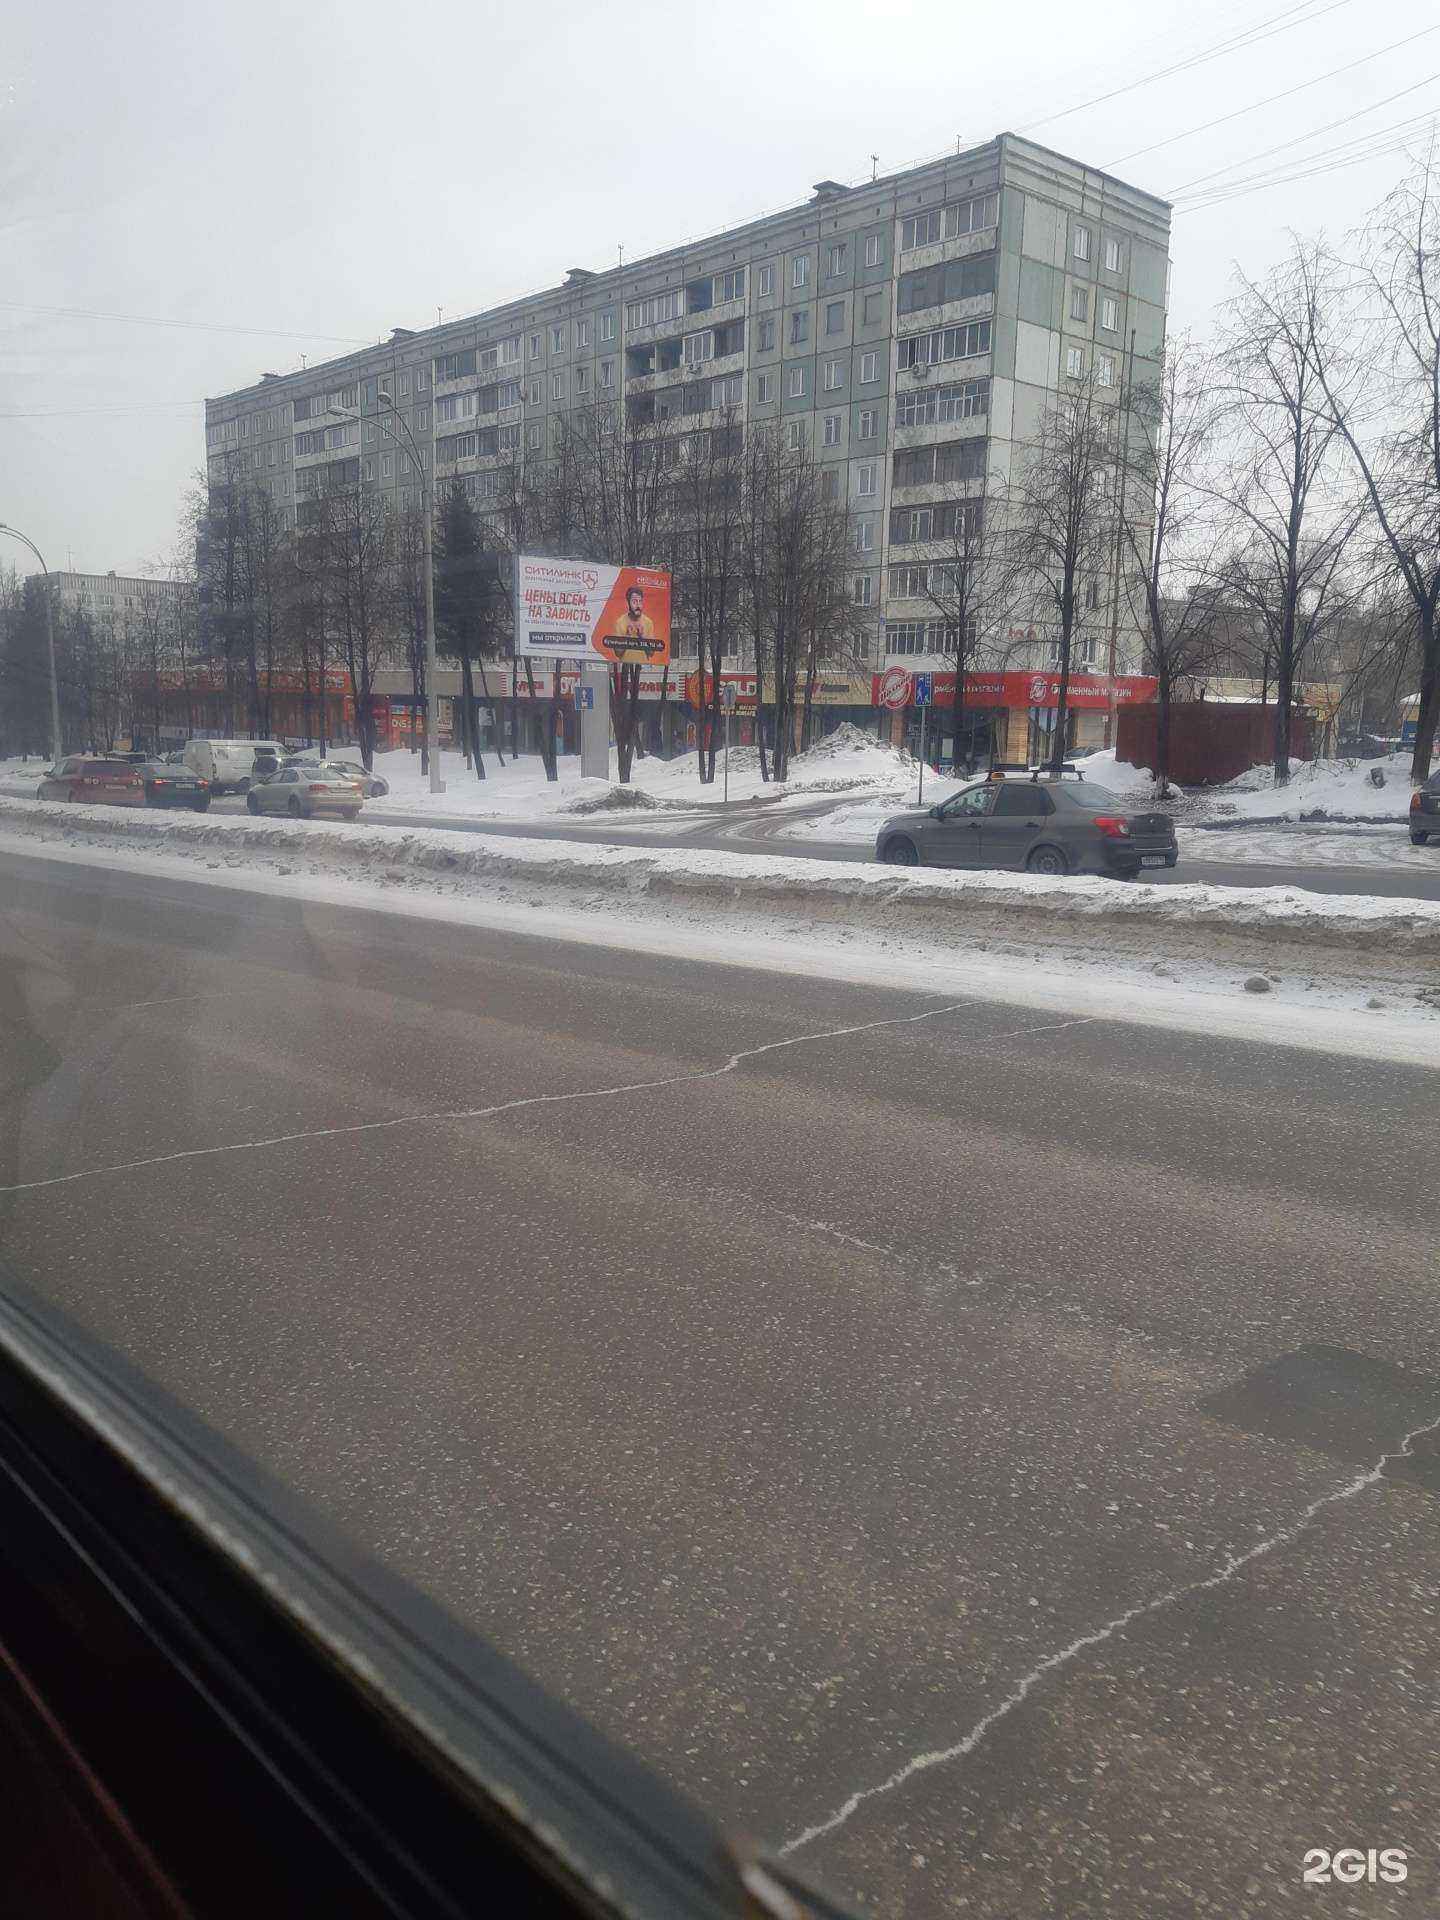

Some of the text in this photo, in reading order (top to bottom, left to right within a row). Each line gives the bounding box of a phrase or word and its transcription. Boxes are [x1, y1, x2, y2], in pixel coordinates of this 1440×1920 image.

[525, 588, 587, 607] ЦЕНЫ ВСЕМ
[528, 605, 592, 622] НА ЗАВИСТЬ
[1100, 687, 1133, 697] маазин
